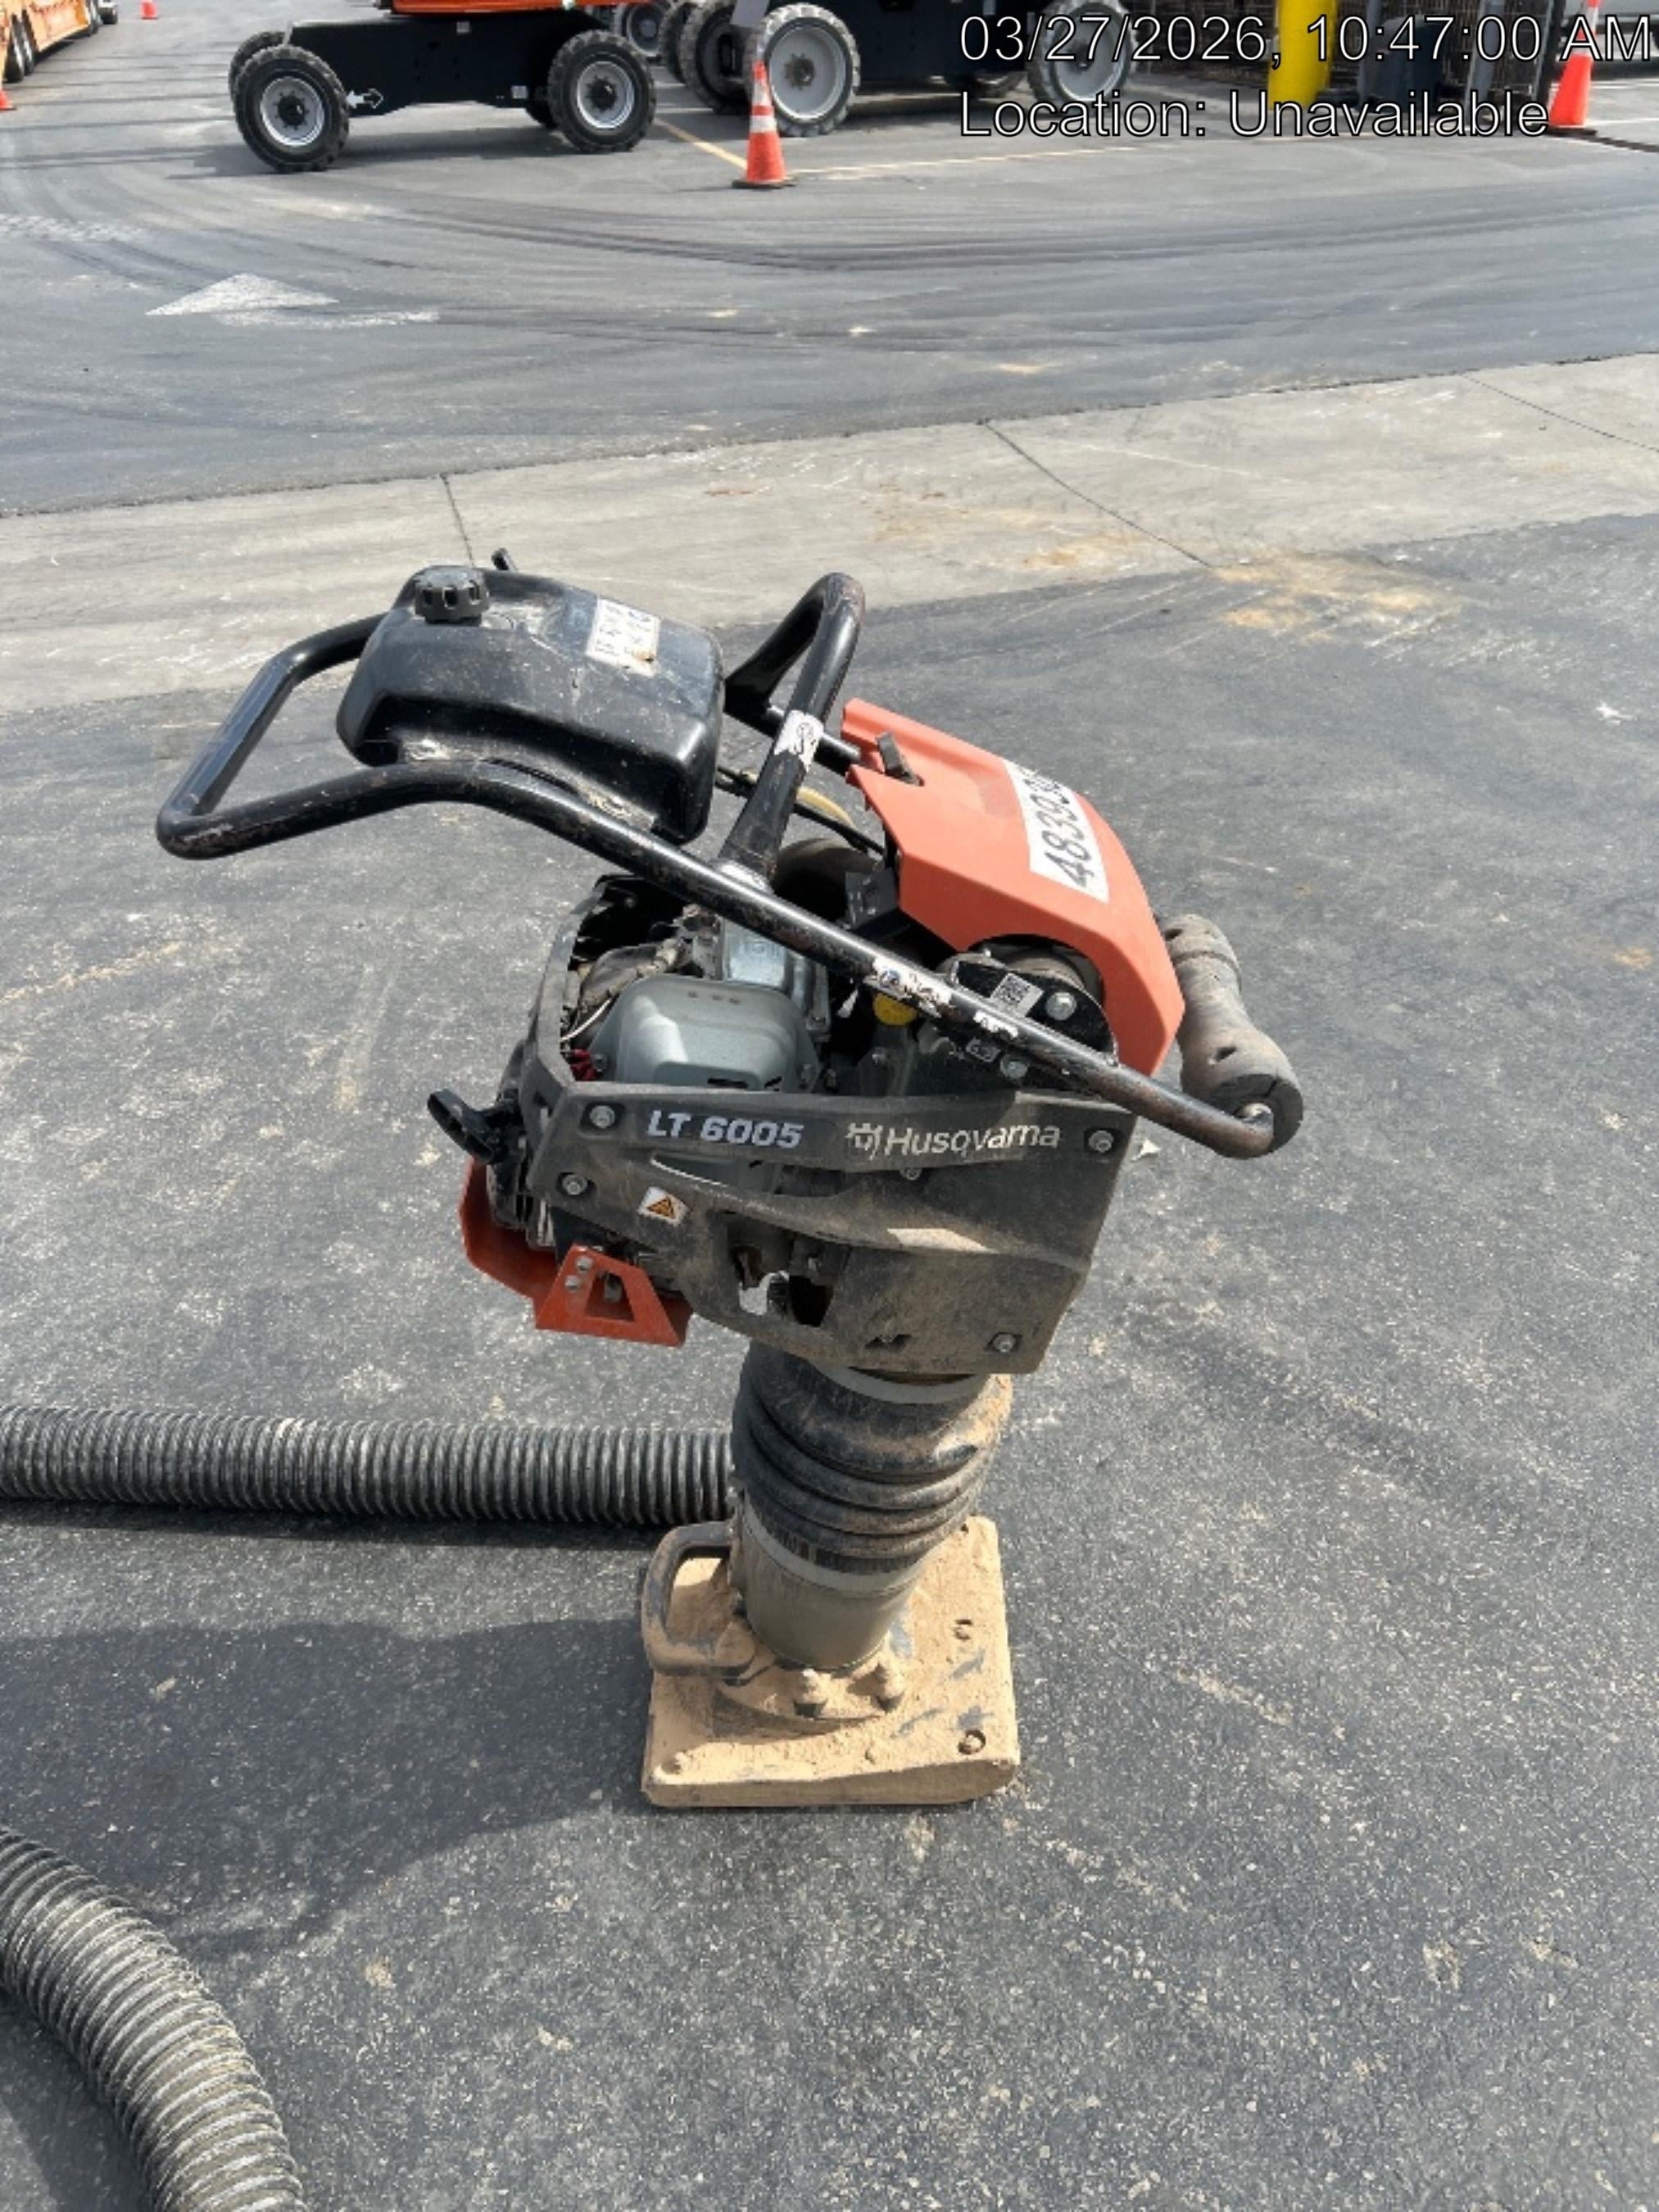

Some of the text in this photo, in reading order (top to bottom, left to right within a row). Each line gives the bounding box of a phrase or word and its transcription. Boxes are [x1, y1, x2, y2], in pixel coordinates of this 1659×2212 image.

[647, 1109, 805, 1149] LT 6005
[884, 1124, 1061, 1158] Husqvarna
